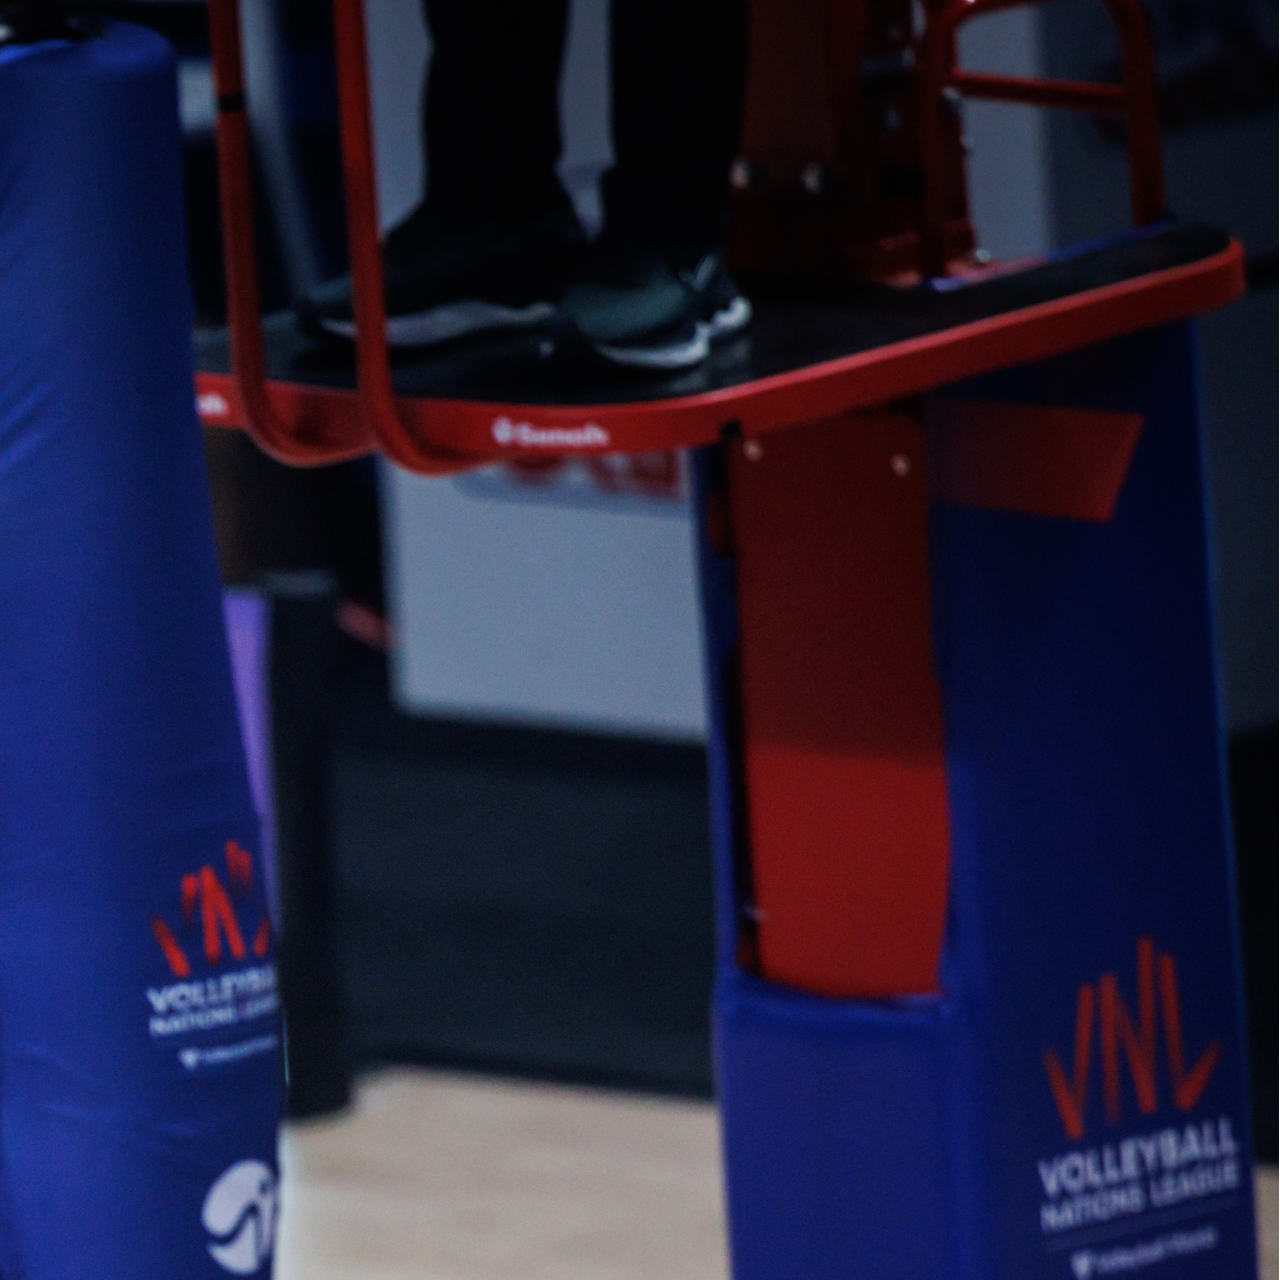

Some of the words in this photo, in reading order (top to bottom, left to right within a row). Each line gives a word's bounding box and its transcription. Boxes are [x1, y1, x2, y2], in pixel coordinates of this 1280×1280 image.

[1042, 936, 1223, 1141] VNL
[1038, 1115, 1237, 1198] VOLLEYBALL
[1041, 1182, 1145, 1231] NATIONS
